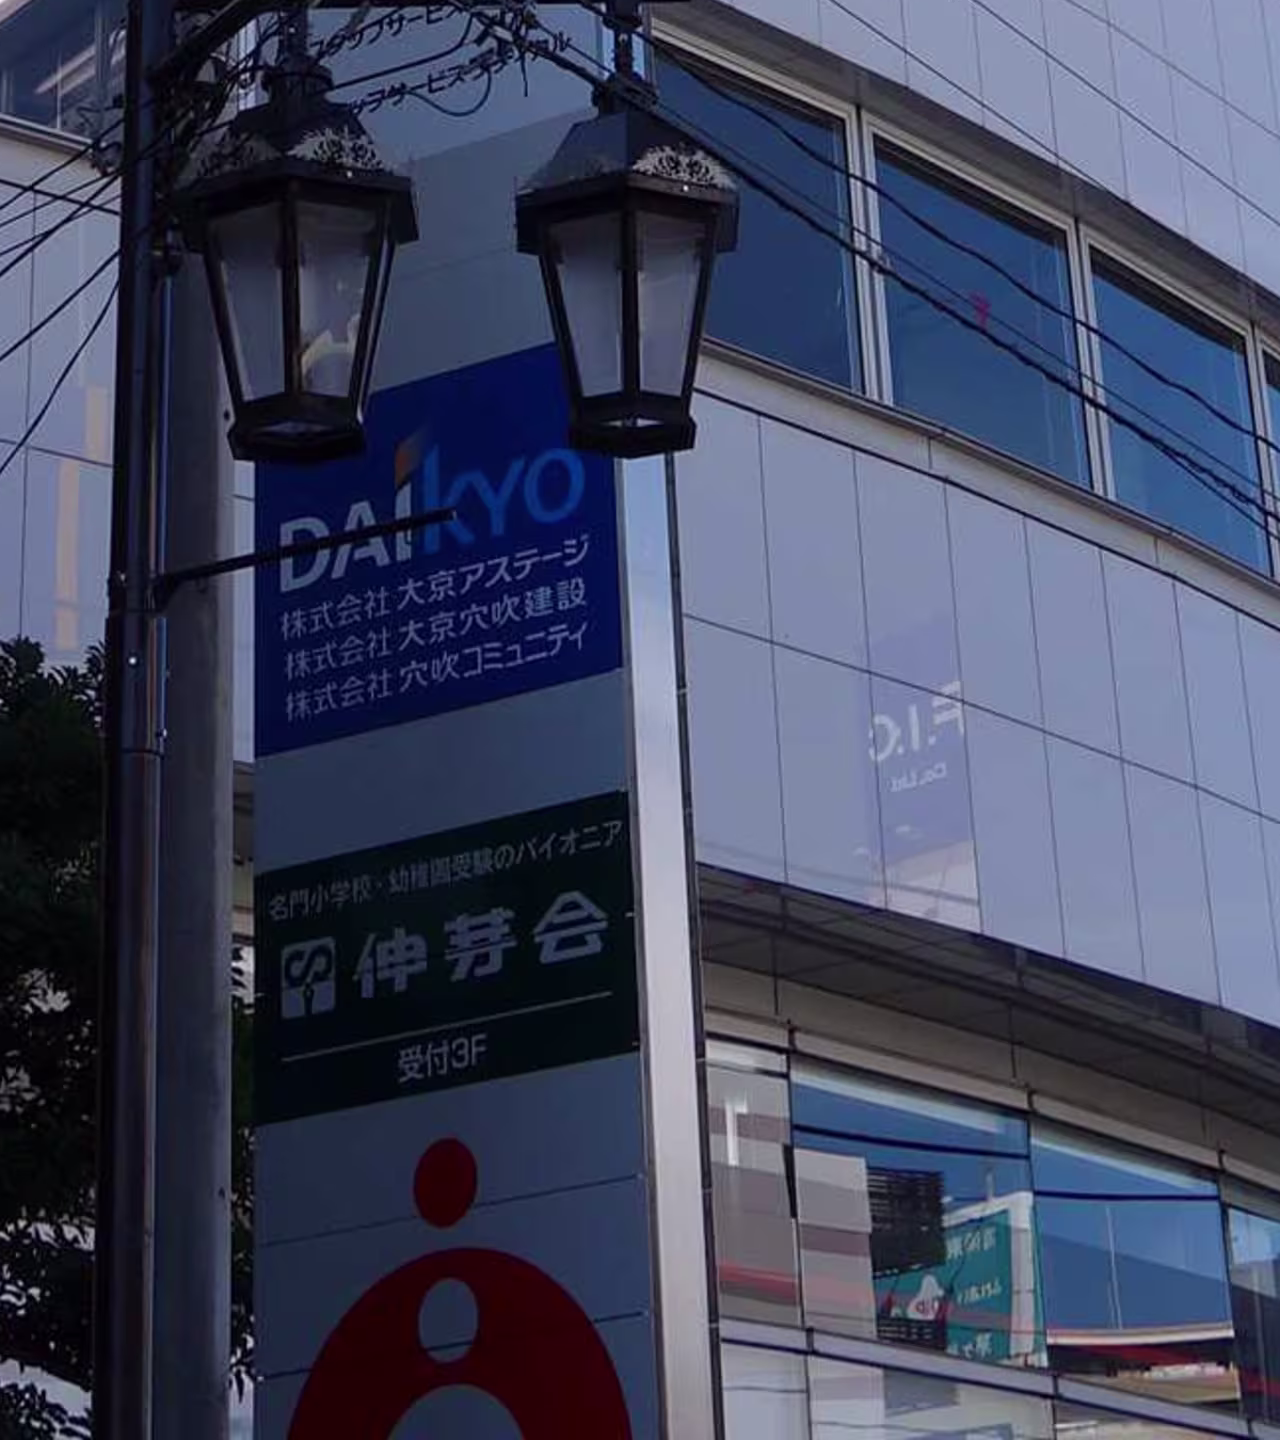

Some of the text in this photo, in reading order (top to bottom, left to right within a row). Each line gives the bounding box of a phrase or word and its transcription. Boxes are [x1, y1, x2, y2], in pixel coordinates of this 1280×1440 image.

[280, 533, 590, 641] 株式会社 大京アステージ
[284, 576, 588, 681] 株式会社 大京穴吹建設
[284, 620, 590, 722] 株式会社 穴吹コミュニティ
[351, 889, 610, 1000] 伸芽会
[397, 1033, 489, 1083] 受付3F
